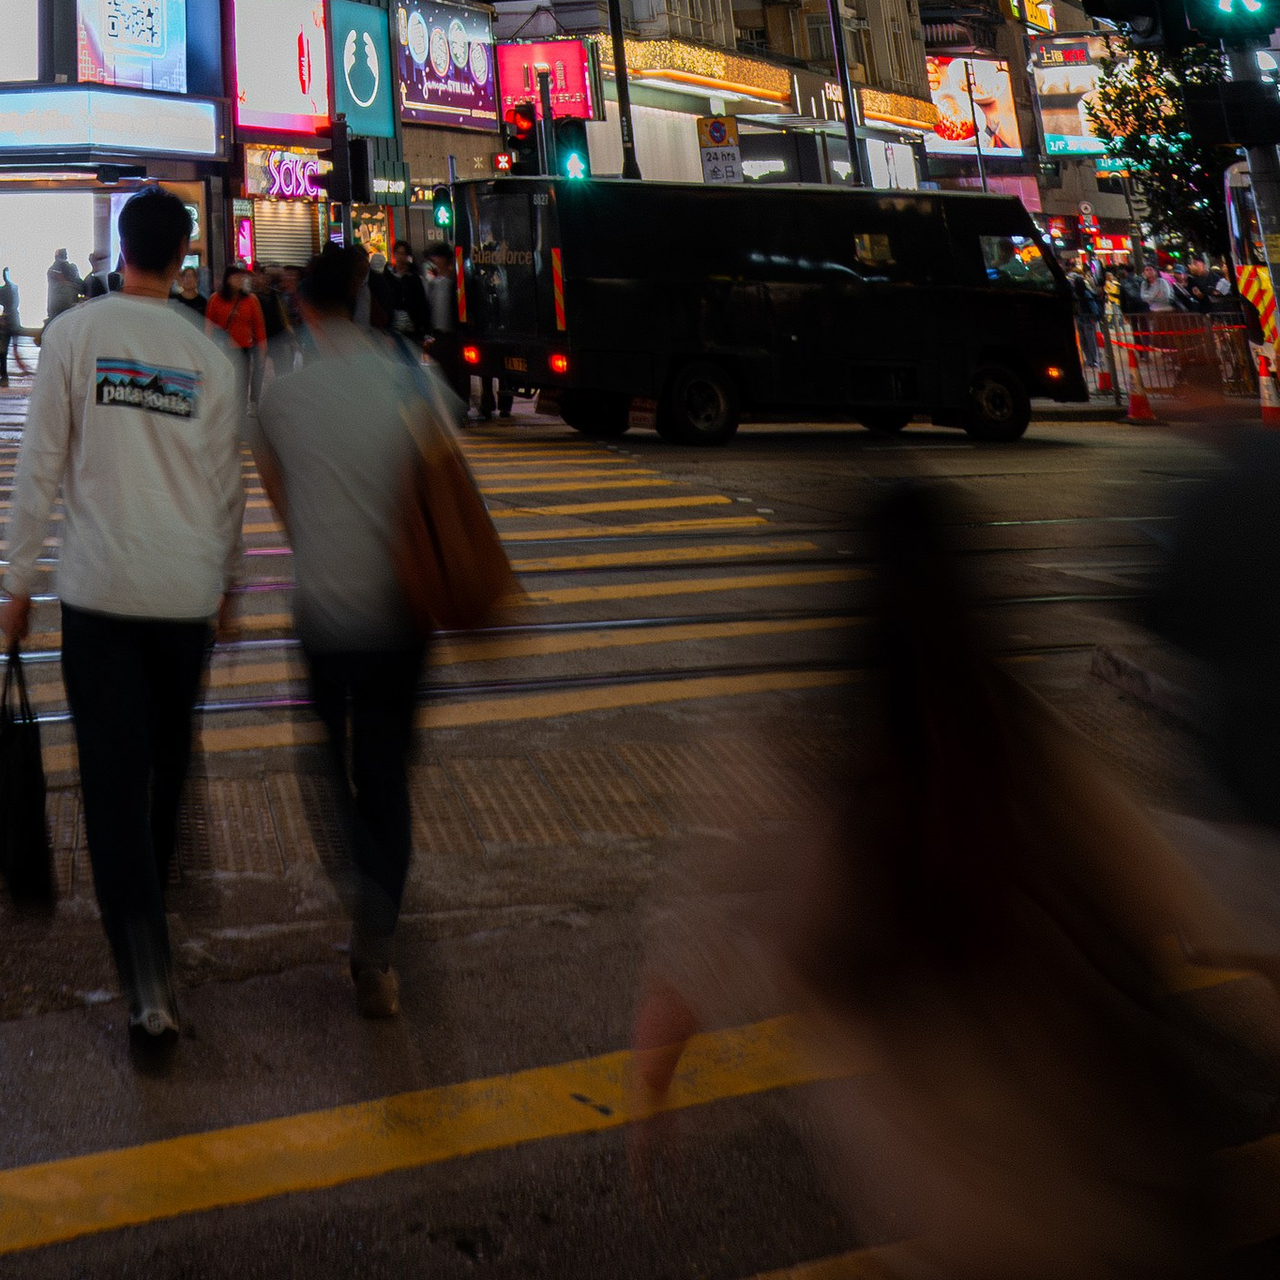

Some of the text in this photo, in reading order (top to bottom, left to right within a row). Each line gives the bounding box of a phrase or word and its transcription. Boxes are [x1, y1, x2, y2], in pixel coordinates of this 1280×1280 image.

[1050, 140, 1065, 151] 1/F
[706, 150, 736, 162] 24 hrs
[710, 166, 735, 180] 全日
